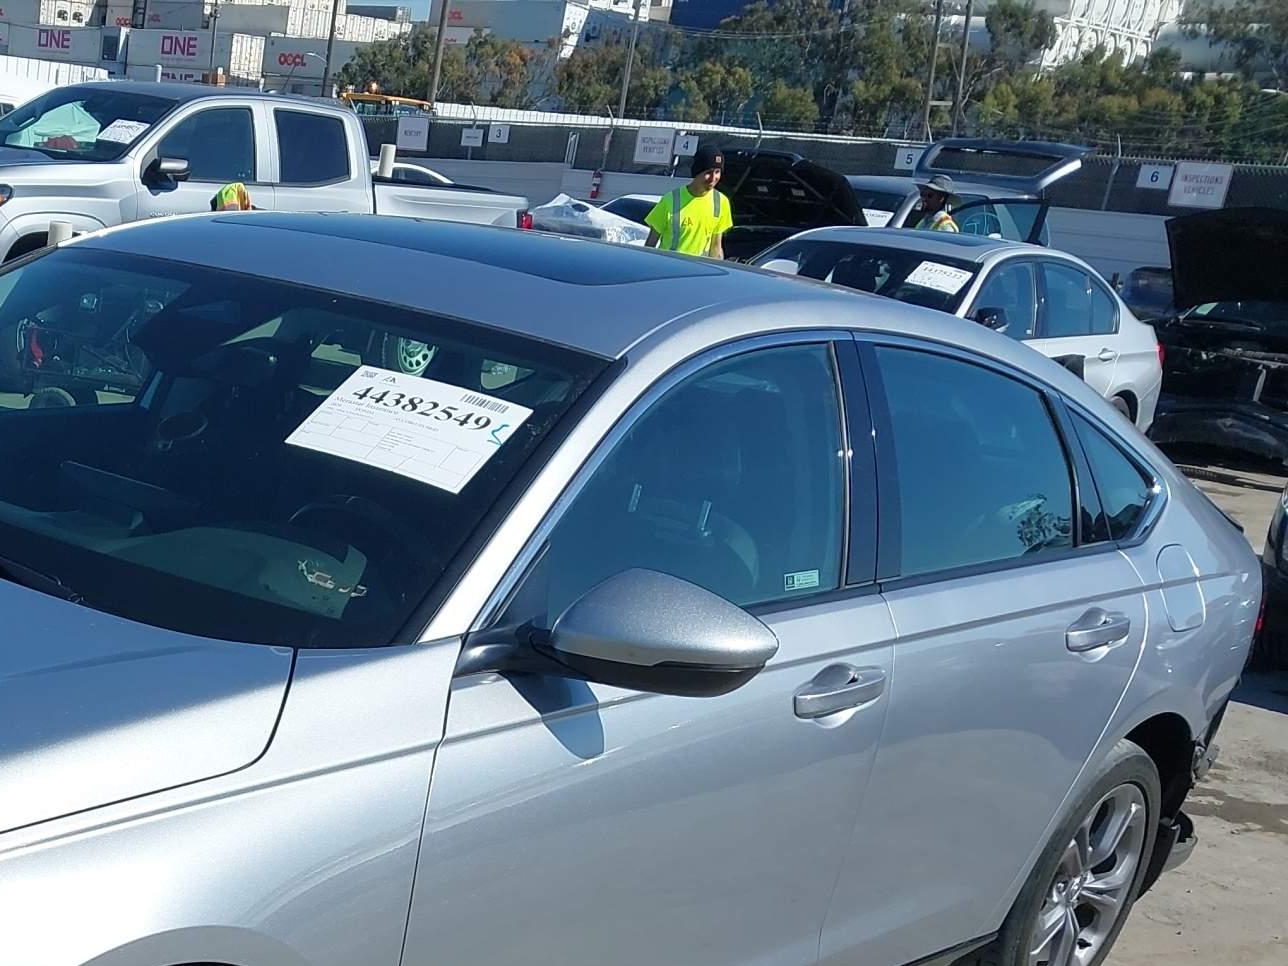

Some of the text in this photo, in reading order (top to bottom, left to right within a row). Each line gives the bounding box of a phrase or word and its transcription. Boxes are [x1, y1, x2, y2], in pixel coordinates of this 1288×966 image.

[38, 29, 71, 49] ONE
[161, 35, 197, 56] ONE
[278, 52, 307, 67] OOCL
[496, 128, 502, 138] 3
[683, 140, 689, 151] 4
[906, 154, 913, 164] 5
[1151, 171, 1160, 183] 6
[352, 386, 492, 431] 44382549
